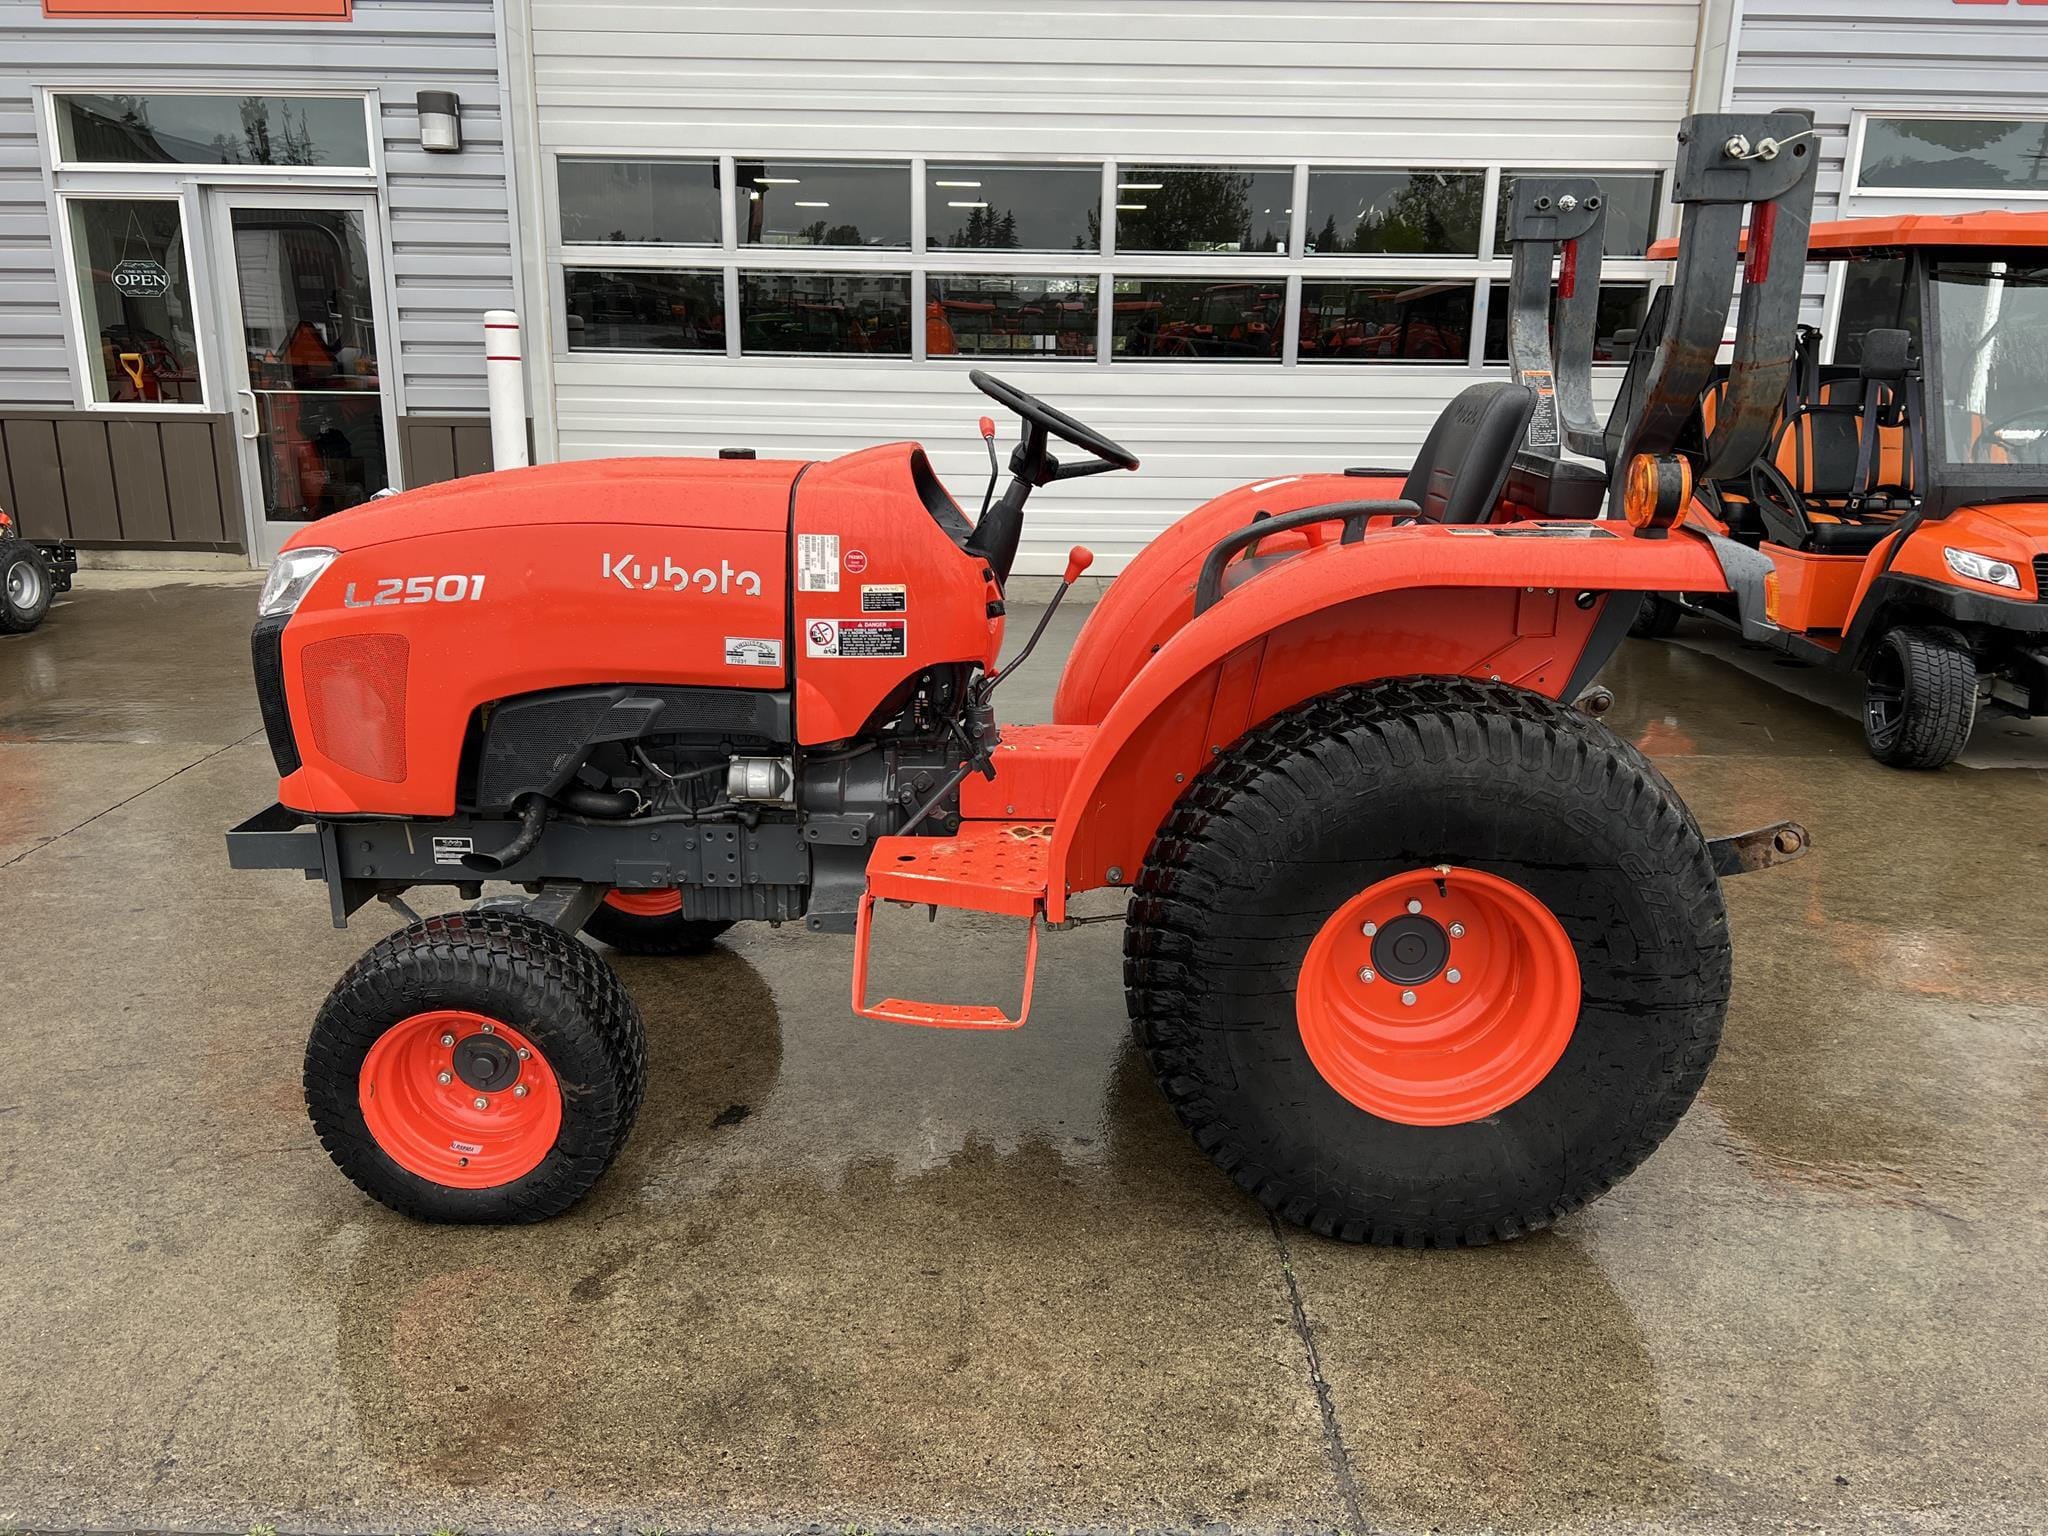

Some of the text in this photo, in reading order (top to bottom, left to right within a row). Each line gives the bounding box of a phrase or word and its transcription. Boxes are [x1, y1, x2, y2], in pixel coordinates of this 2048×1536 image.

[115, 274, 167, 286] OPEN
[344, 574, 486, 609] L2501
[603, 552, 761, 596] Kubota
